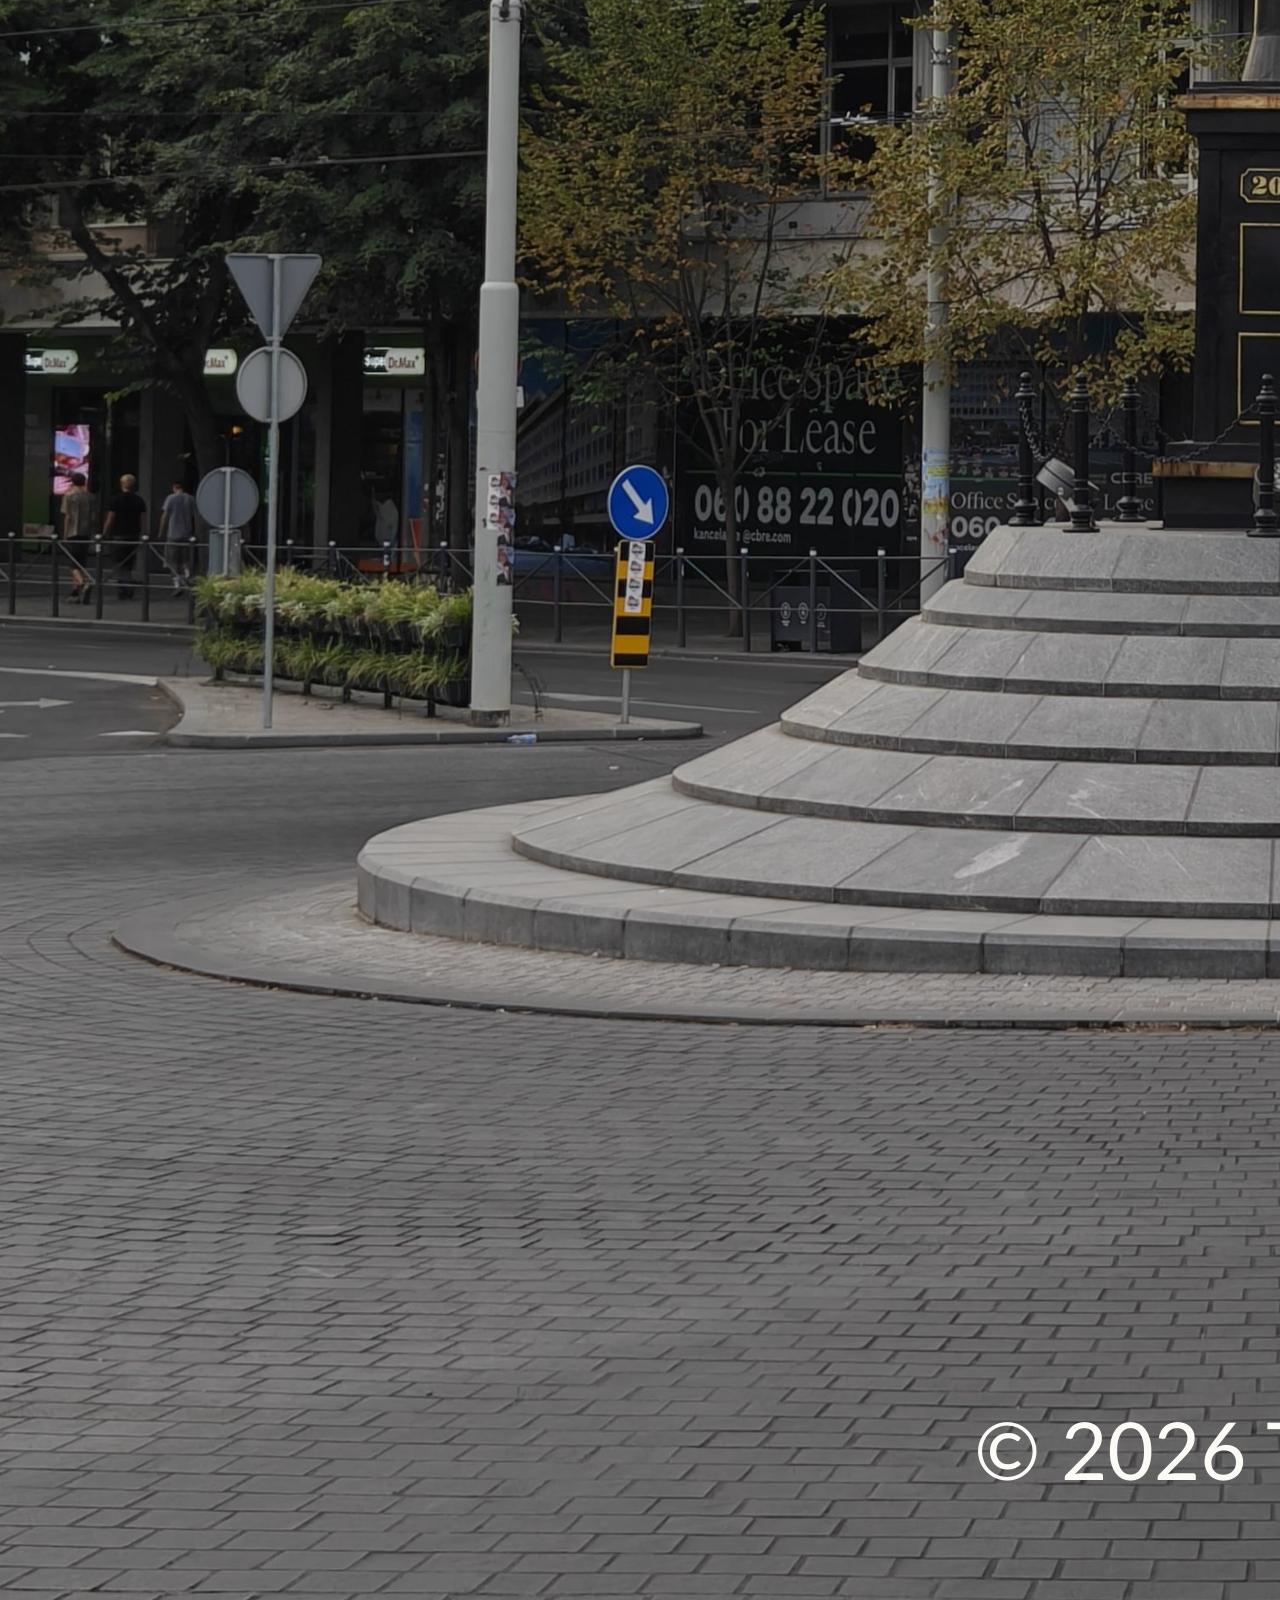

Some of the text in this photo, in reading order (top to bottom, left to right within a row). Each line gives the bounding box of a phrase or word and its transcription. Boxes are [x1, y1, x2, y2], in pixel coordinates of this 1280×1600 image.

[204, 357, 226, 369] r.Max
[782, 406, 877, 455] Lease
[1110, 472, 1154, 485] CRE
[694, 483, 900, 528] 060 88 22 020
[951, 491, 1003, 511] Office
[1104, 493, 1155, 511] Lese
